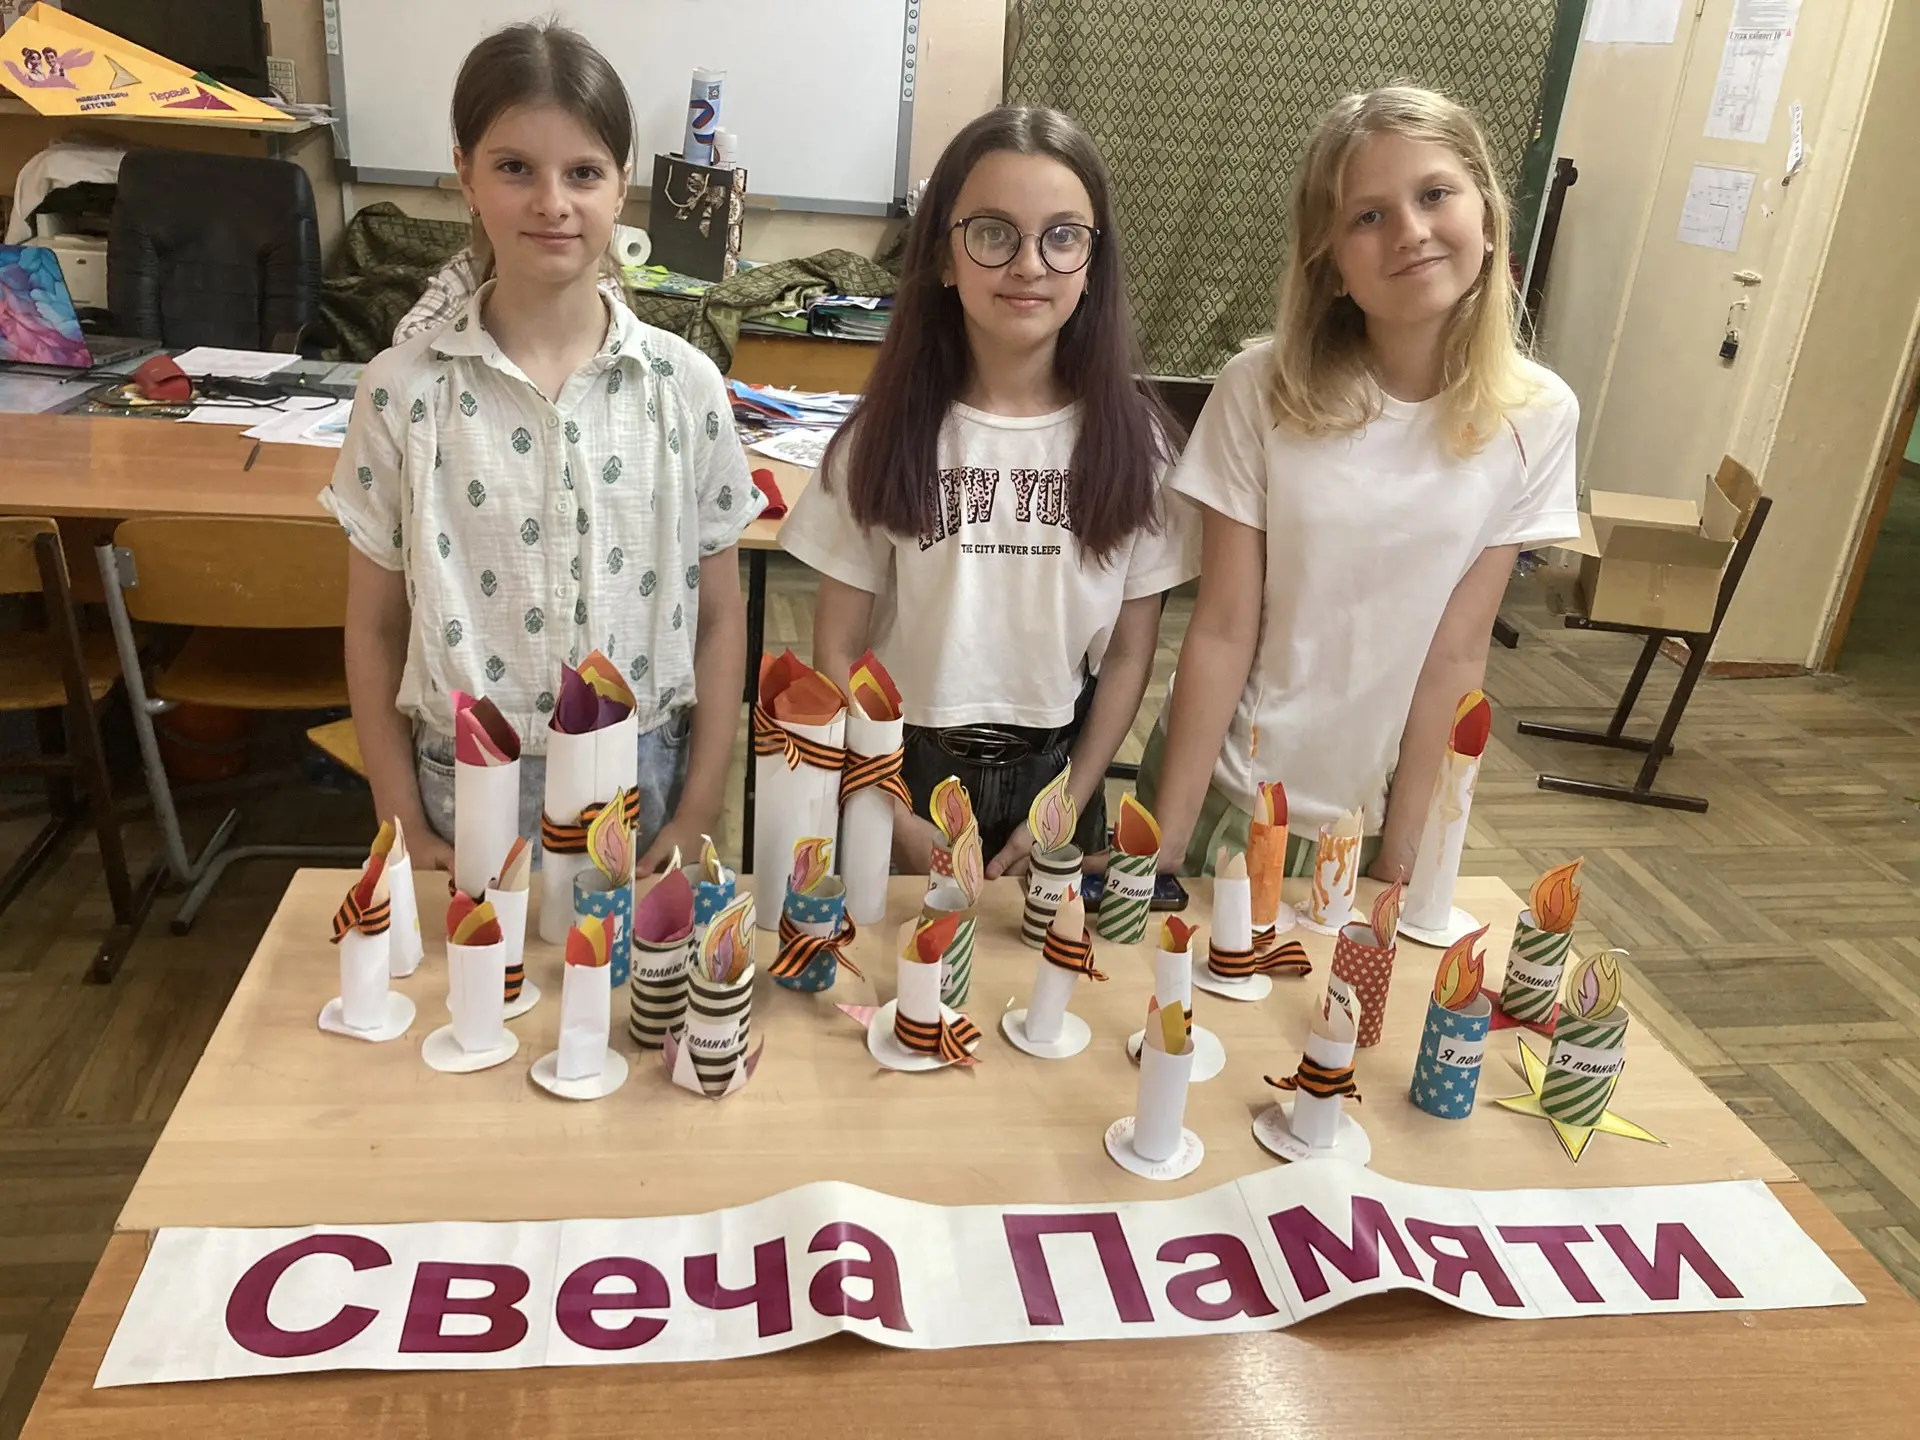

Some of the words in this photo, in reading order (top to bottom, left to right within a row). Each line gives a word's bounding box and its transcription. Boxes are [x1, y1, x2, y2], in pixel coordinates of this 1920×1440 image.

[149, 87, 191, 103] Первые
[1010, 469, 1073, 530] YO
[974, 544, 995, 554] CITY
[998, 544, 1029, 556] NEVER
[1030, 545, 1061, 556] SLEEPS
[1031, 885, 1043, 896] Я
[1109, 879, 1121, 889] Я
[640, 954, 689, 978] помню!
[1513, 971, 1559, 987] помню!
[689, 1030, 739, 1049] помню!
[1439, 1048, 1455, 1061] Я
[1555, 1054, 1572, 1066] Я
[1572, 1058, 1623, 1074] помню!
[224, 1221, 914, 1358] Свеча
